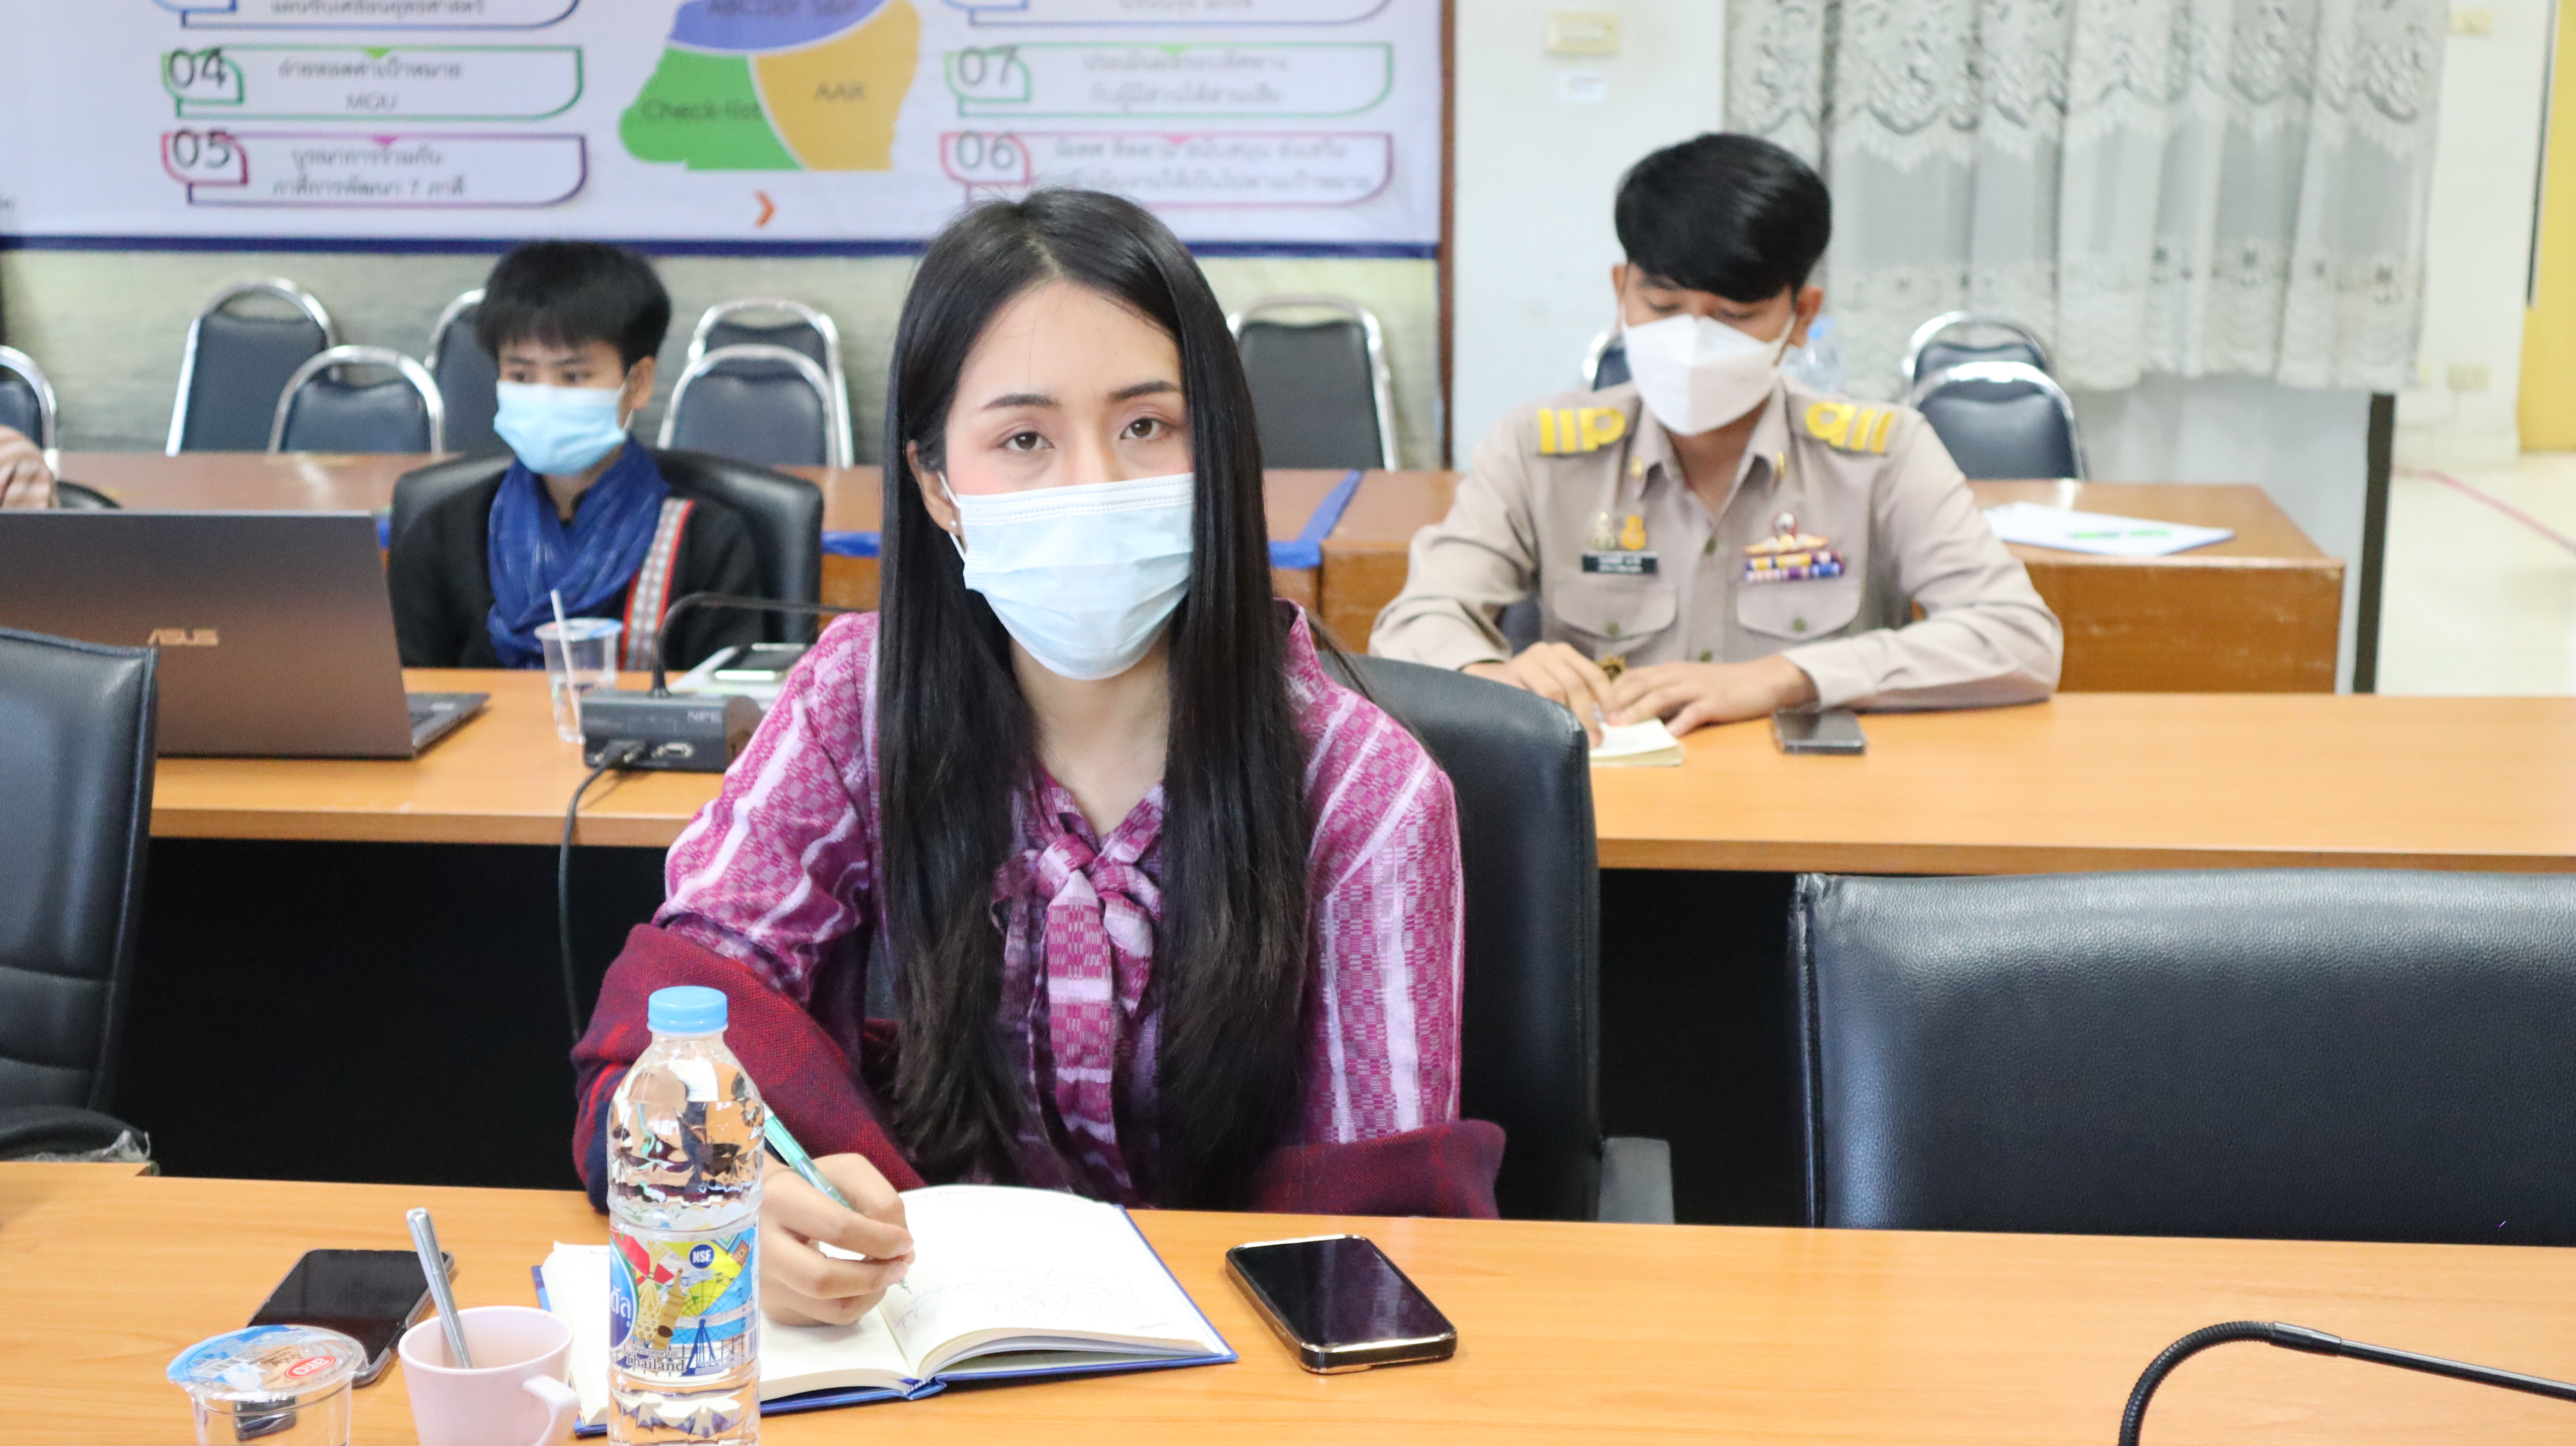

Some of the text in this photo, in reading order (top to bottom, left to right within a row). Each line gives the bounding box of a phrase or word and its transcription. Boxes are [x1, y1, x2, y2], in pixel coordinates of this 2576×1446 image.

[167, 47, 227, 88] 04
[958, 45, 1018, 85] 07
[172, 128, 232, 170] 05
[957, 130, 1015, 170] 06
[692, 1249, 711, 1264] NSF
[626, 1352, 685, 1372] Thailand
[632, 1344, 665, 1357] Welcome
[292, 1357, 330, 1376] aro
